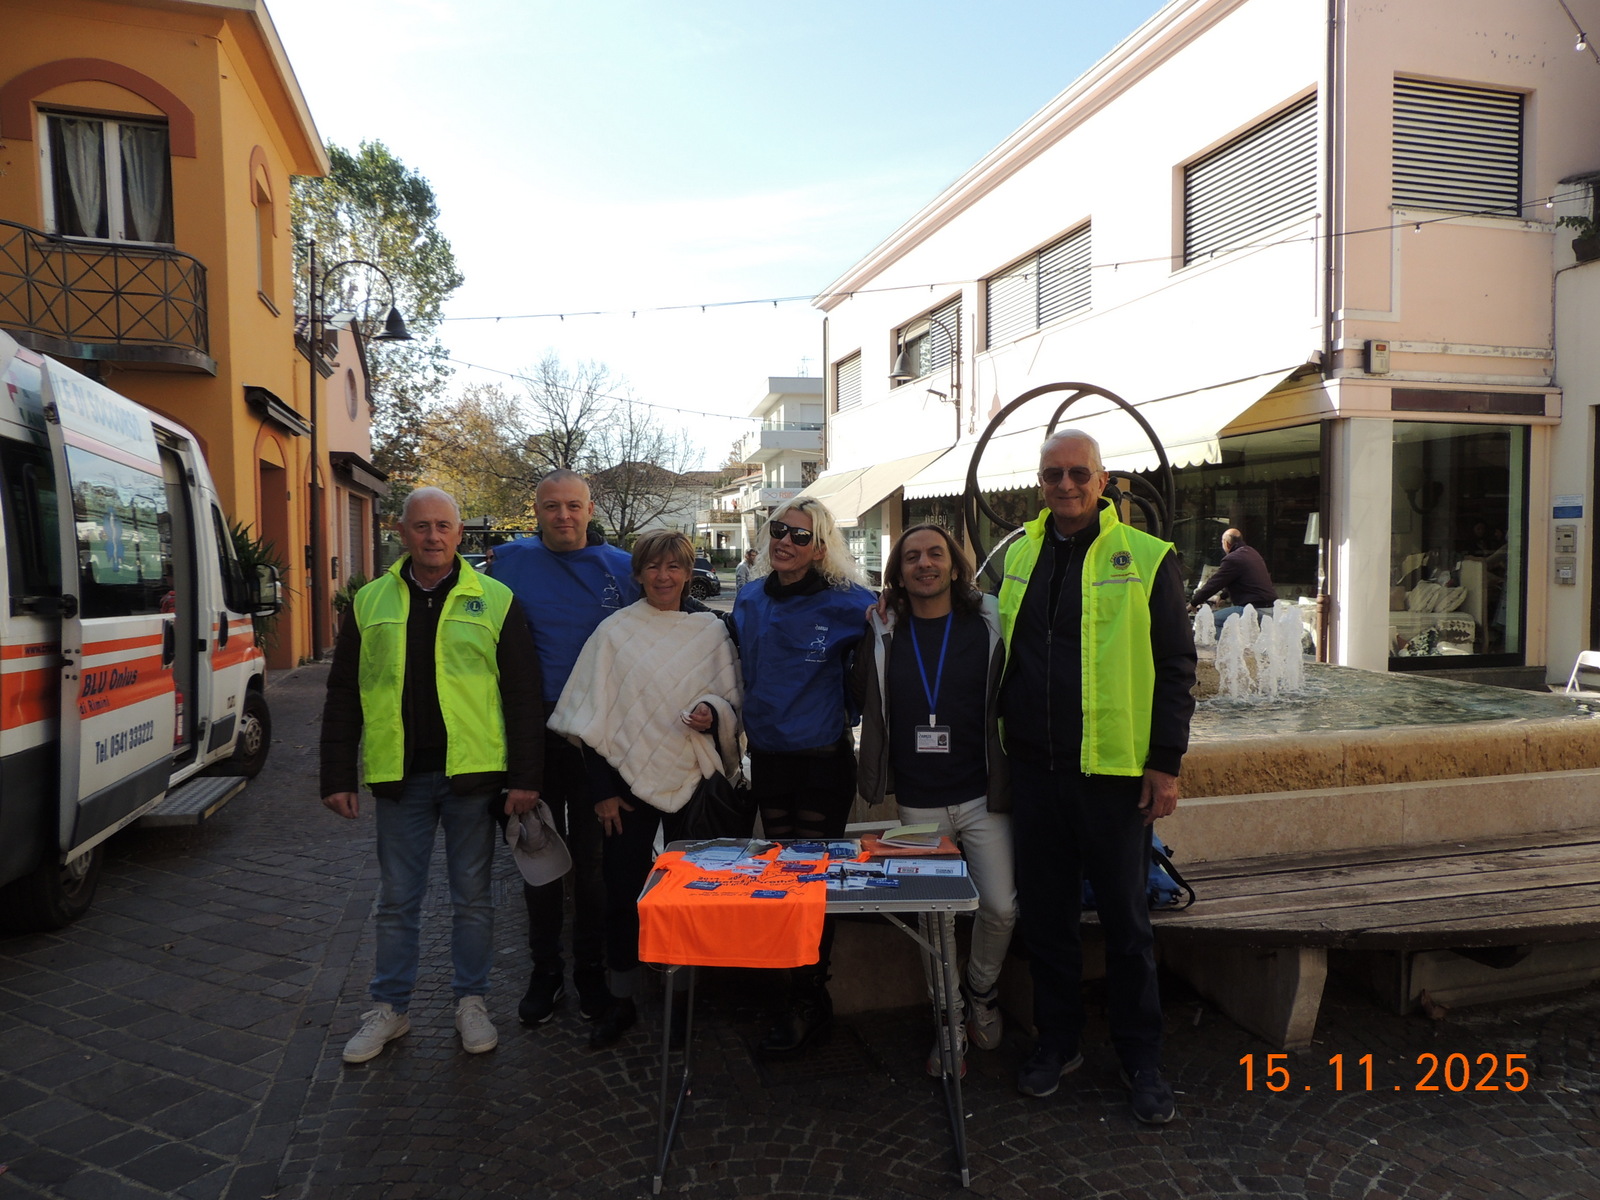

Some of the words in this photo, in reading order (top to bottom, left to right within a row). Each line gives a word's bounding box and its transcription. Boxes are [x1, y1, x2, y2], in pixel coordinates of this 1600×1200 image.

[71, 383, 90, 420] DI
[86, 390, 142, 442] SOCCORSO
[81, 671, 107, 698] BLU
[109, 666, 138, 691] Onlus
[79, 701, 87, 715] di
[88, 696, 110, 713] Rimini
[95, 738, 109, 765] Tel.
[110, 730, 127, 758] 0541
[129, 720, 154, 750] 333222
